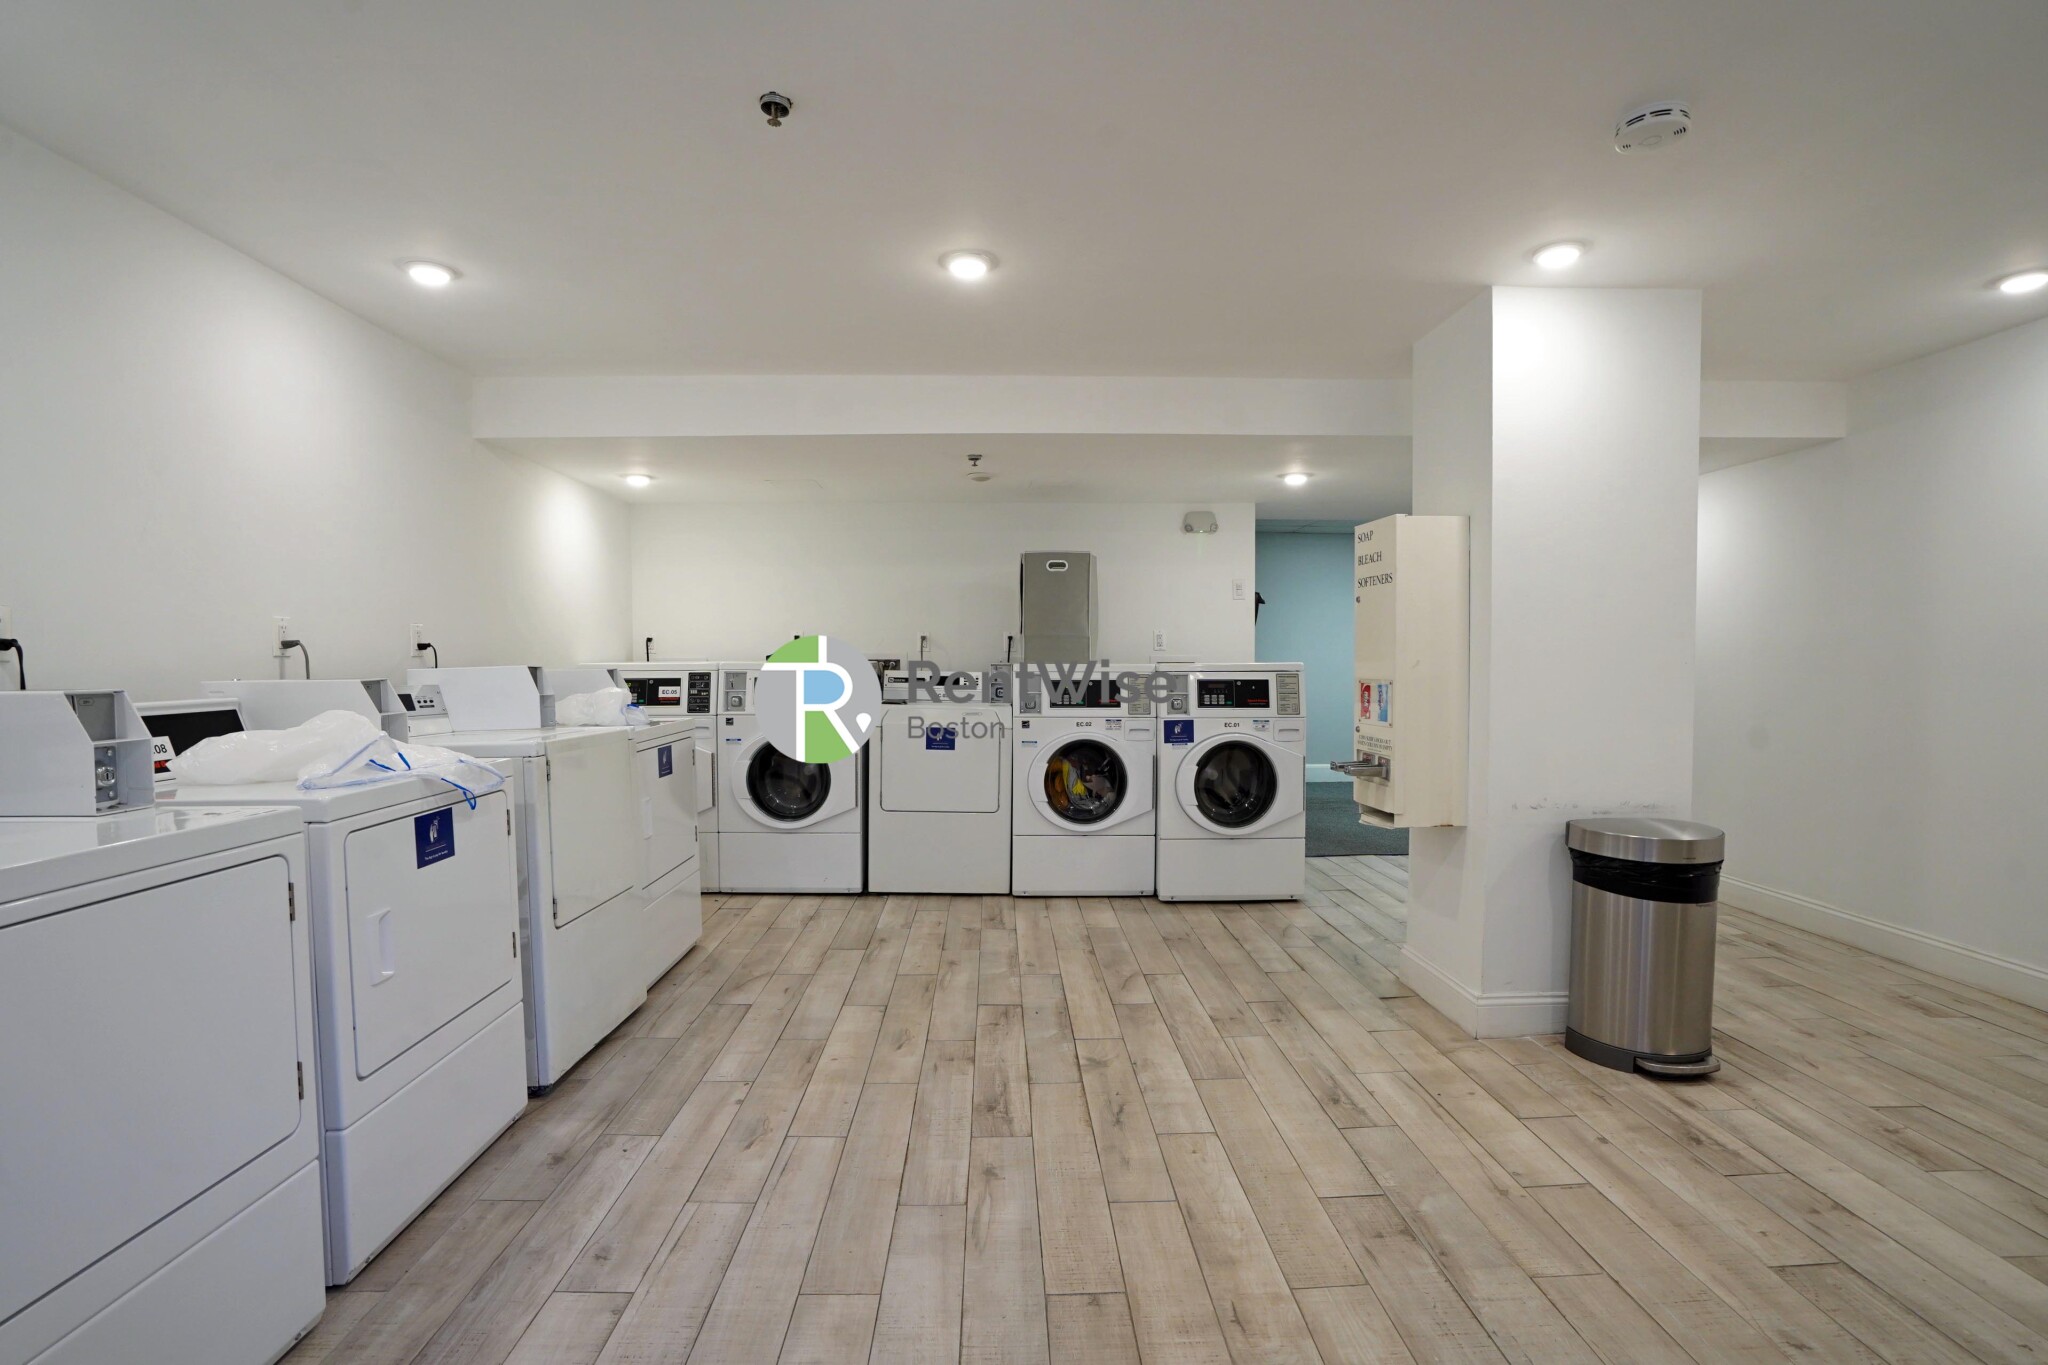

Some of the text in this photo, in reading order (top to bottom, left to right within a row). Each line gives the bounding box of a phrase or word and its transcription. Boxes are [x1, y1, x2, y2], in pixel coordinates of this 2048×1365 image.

[1357, 530, 1374, 543] SOAP
[1357, 551, 1382, 566] BLEACH
[1357, 573, 1393, 588] SOFTENERS
